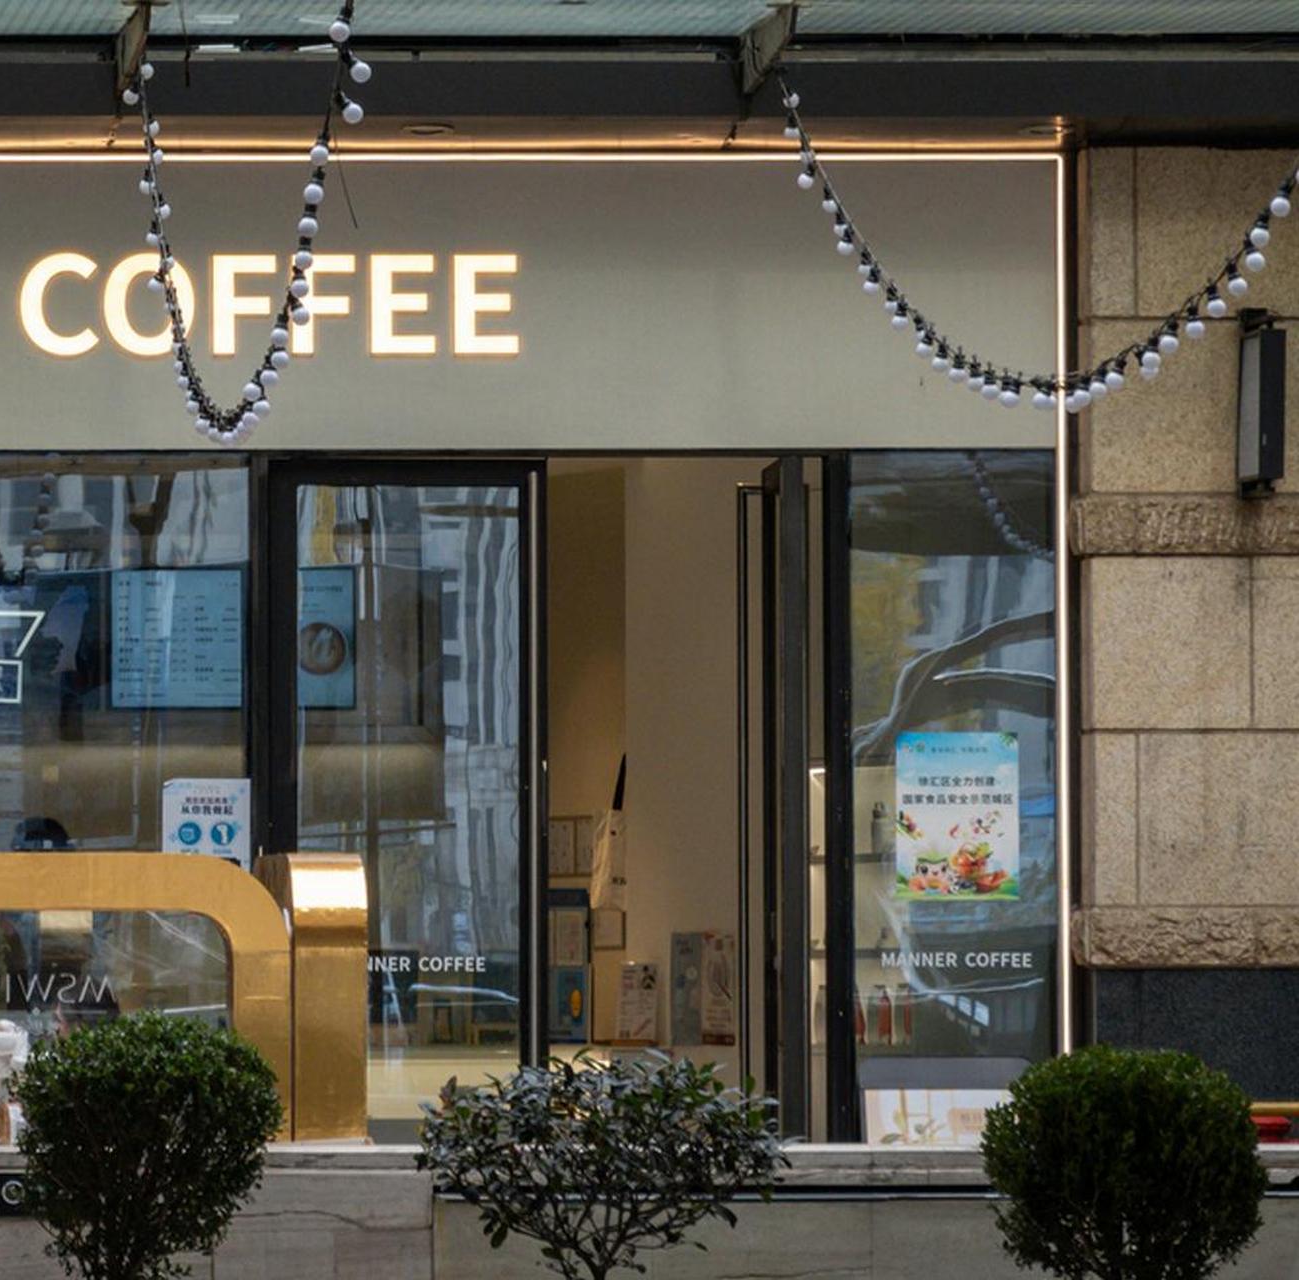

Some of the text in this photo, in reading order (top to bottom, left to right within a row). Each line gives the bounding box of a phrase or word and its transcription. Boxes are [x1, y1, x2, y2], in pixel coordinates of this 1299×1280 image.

[19, 252, 521, 357] COFFEE
[918, 776, 996, 787] 徐汇区全力创建
[902, 794, 1014, 805] 国家食品安全示范城区
[368, 956, 487, 973] NER COFFEE
[880, 951, 1033, 968] MANNER COFFEE
